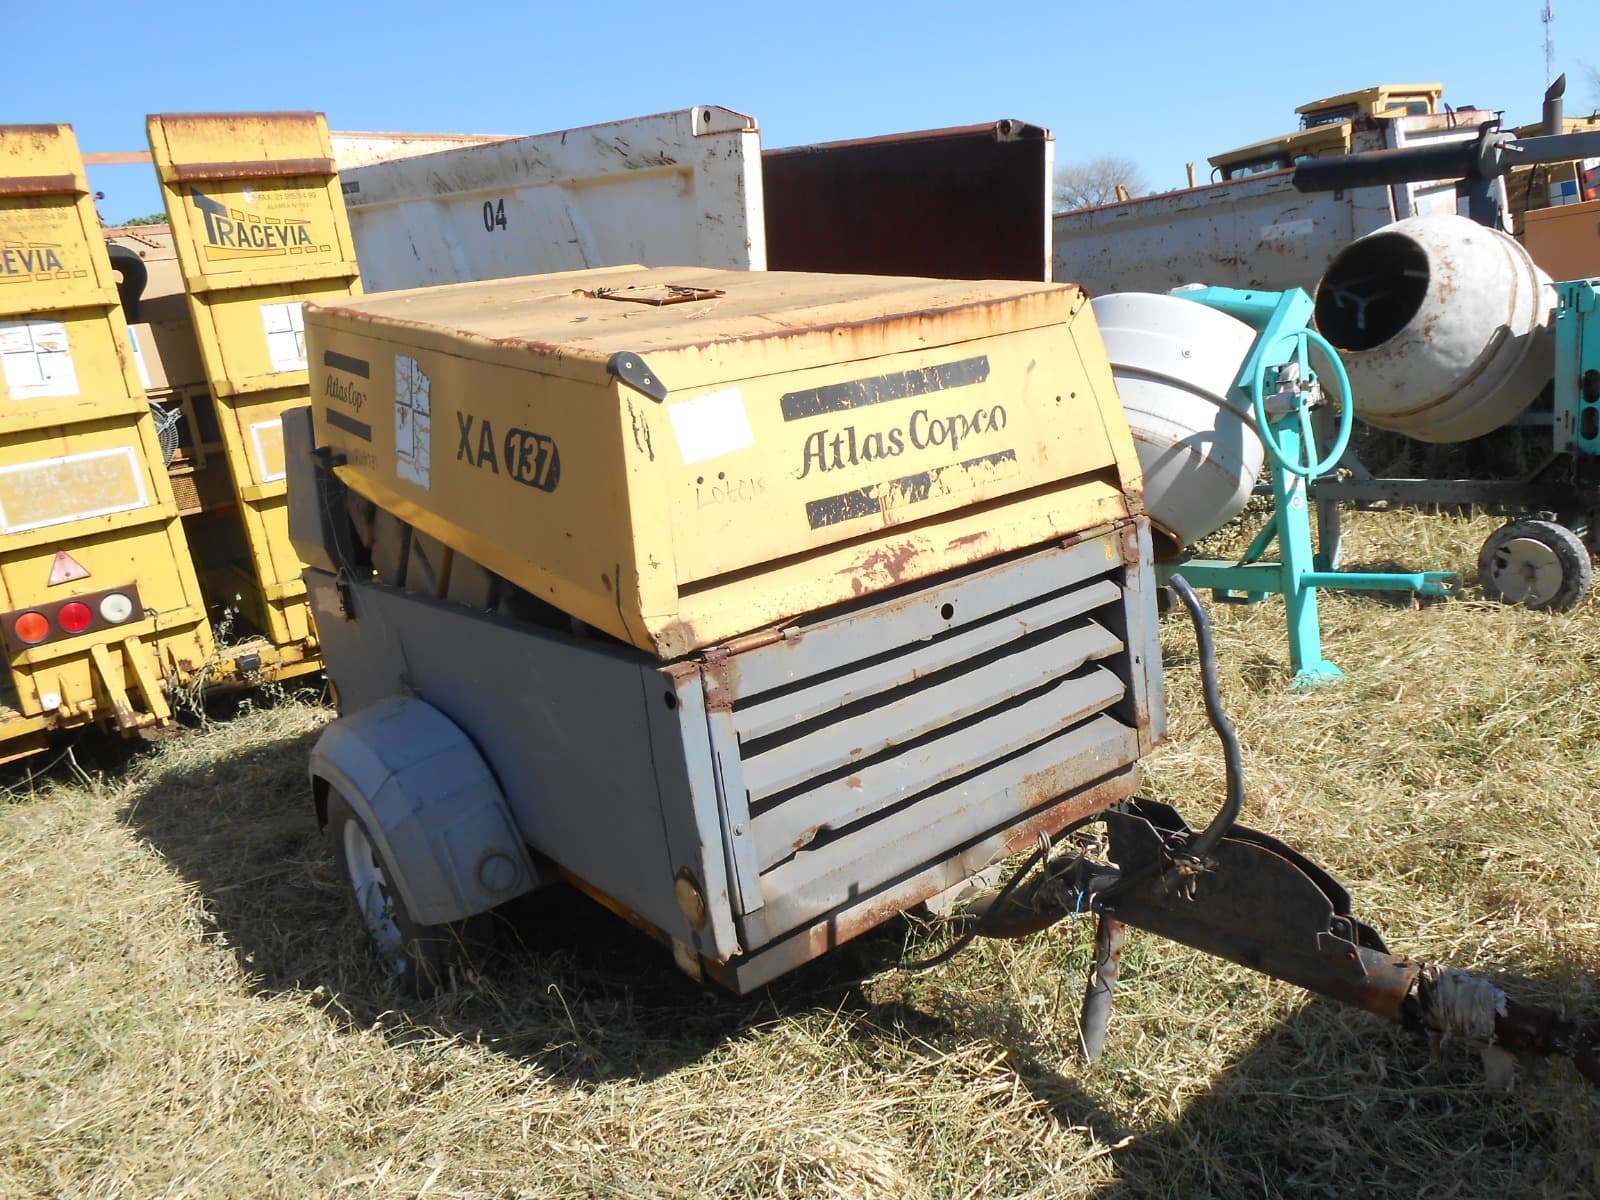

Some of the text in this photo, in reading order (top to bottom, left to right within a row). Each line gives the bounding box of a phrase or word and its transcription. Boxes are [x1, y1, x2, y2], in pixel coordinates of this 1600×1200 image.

[190, 187, 313, 249] TRACEVIA
[483, 199, 507, 232] 04
[325, 374, 348, 403] Atlas
[456, 411, 556, 484] XA 137
[796, 405, 1007, 480] Atlas Copco
